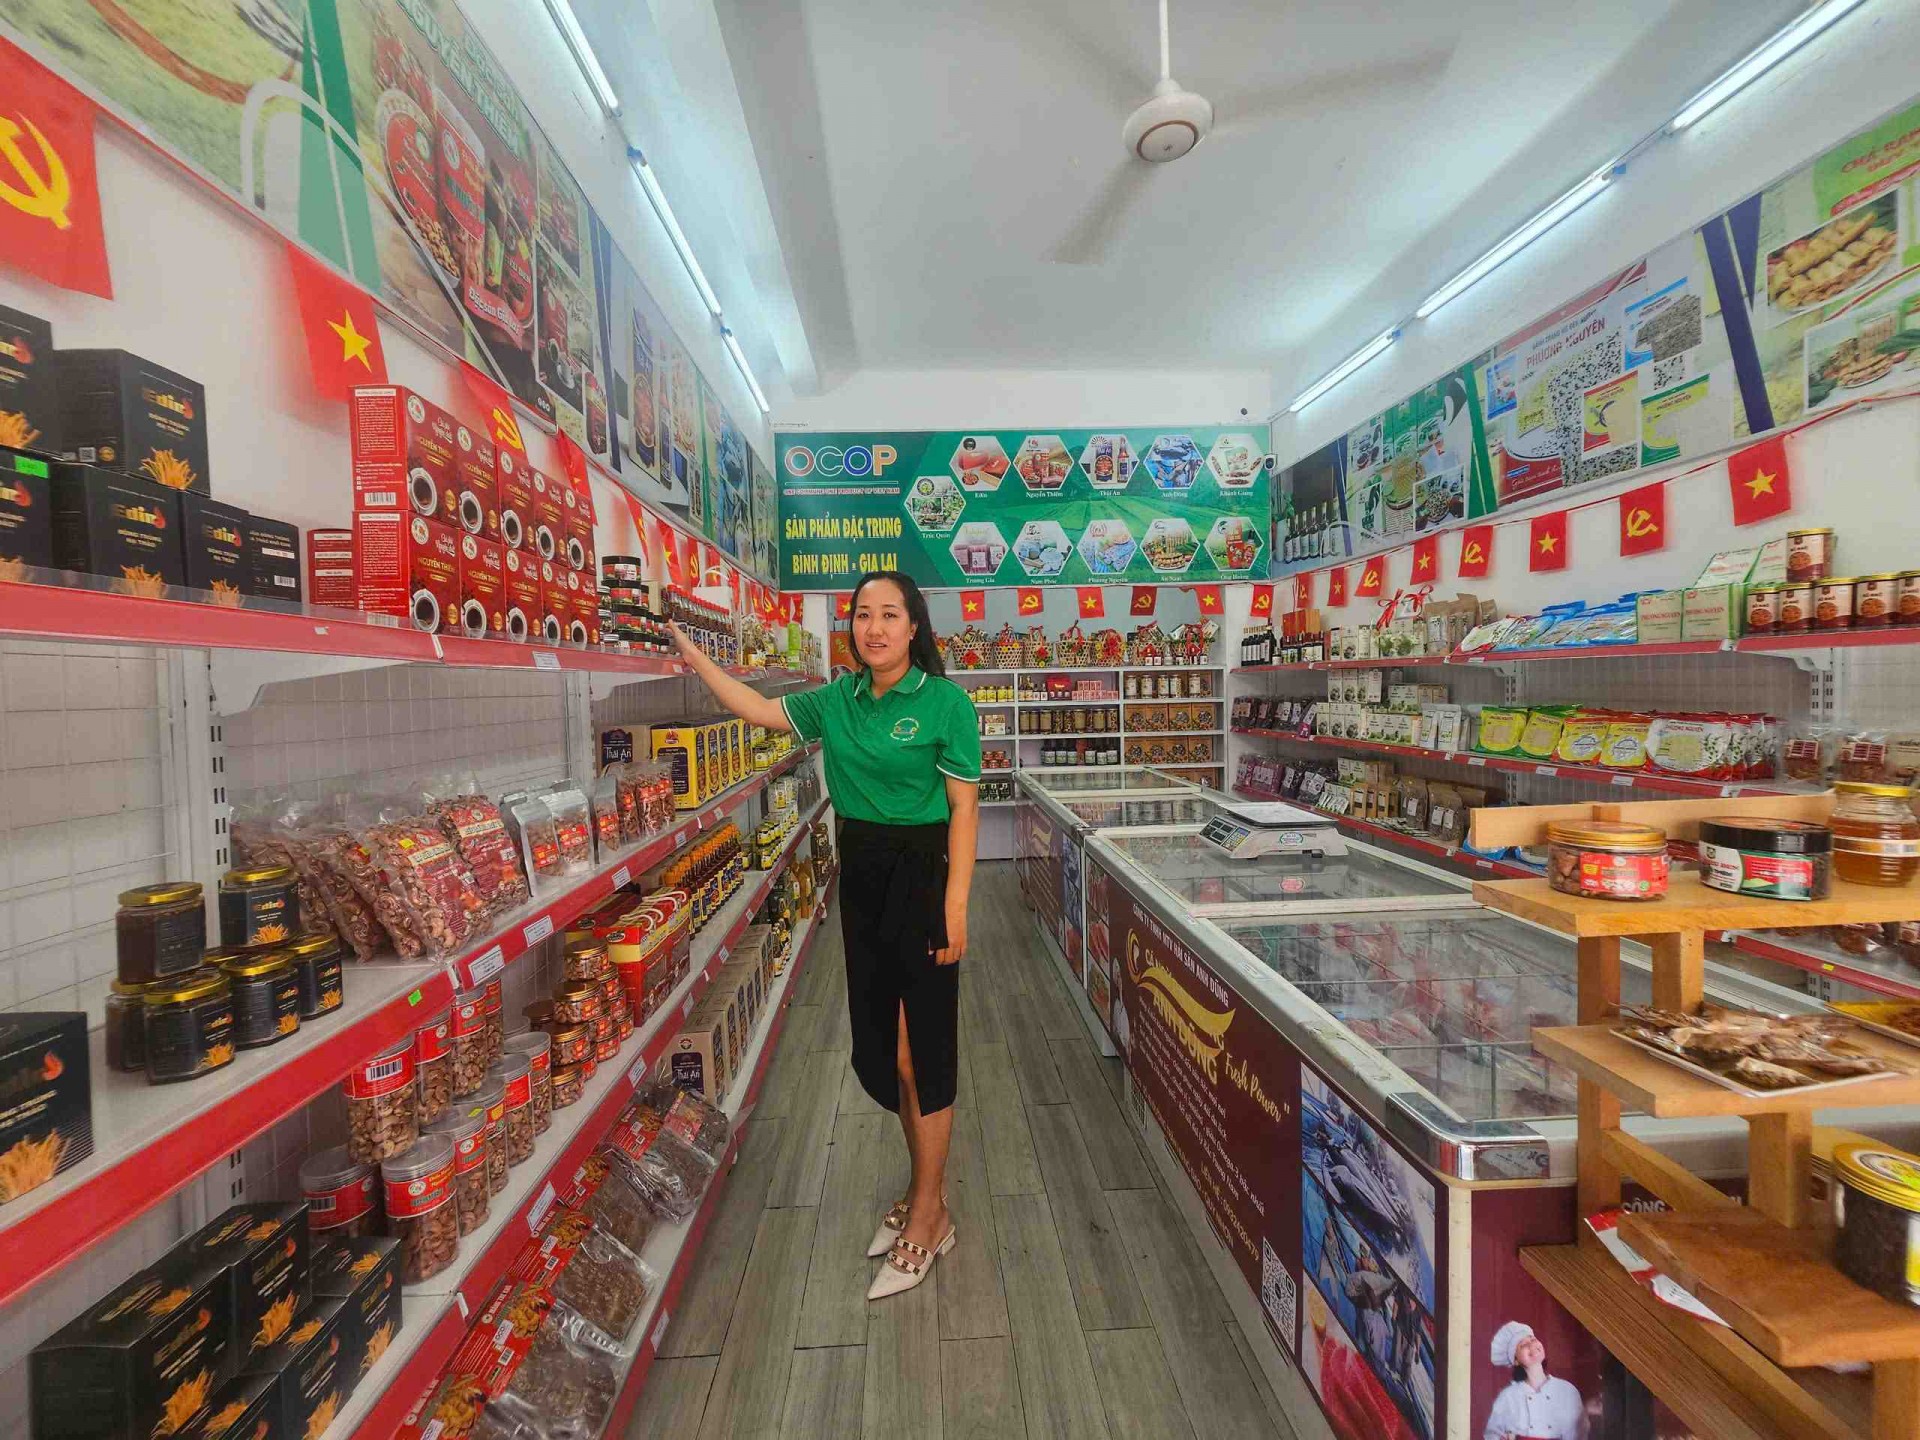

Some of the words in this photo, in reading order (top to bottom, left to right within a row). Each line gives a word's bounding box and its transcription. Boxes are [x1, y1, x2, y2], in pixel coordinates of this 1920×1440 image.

[784, 444, 898, 477] OCOP
[866, 517, 902, 539] TRUNG
[792, 550, 819, 575] BÌNH
[821, 554, 849, 580] ĐỊNH
[859, 553, 879, 574] GIA
[881, 553, 898, 572] LAI
[1195, 964, 1209, 984] ANH
[1210, 975, 1229, 1007] DŨNG
[1178, 1023, 1218, 1085] DŨNG
[1225, 1052, 1248, 1090] Fresh
[1250, 1072, 1281, 1123] Power
[1226, 1176, 1239, 1201] Nam
[1621, 1197, 1666, 1213] CÔNG
